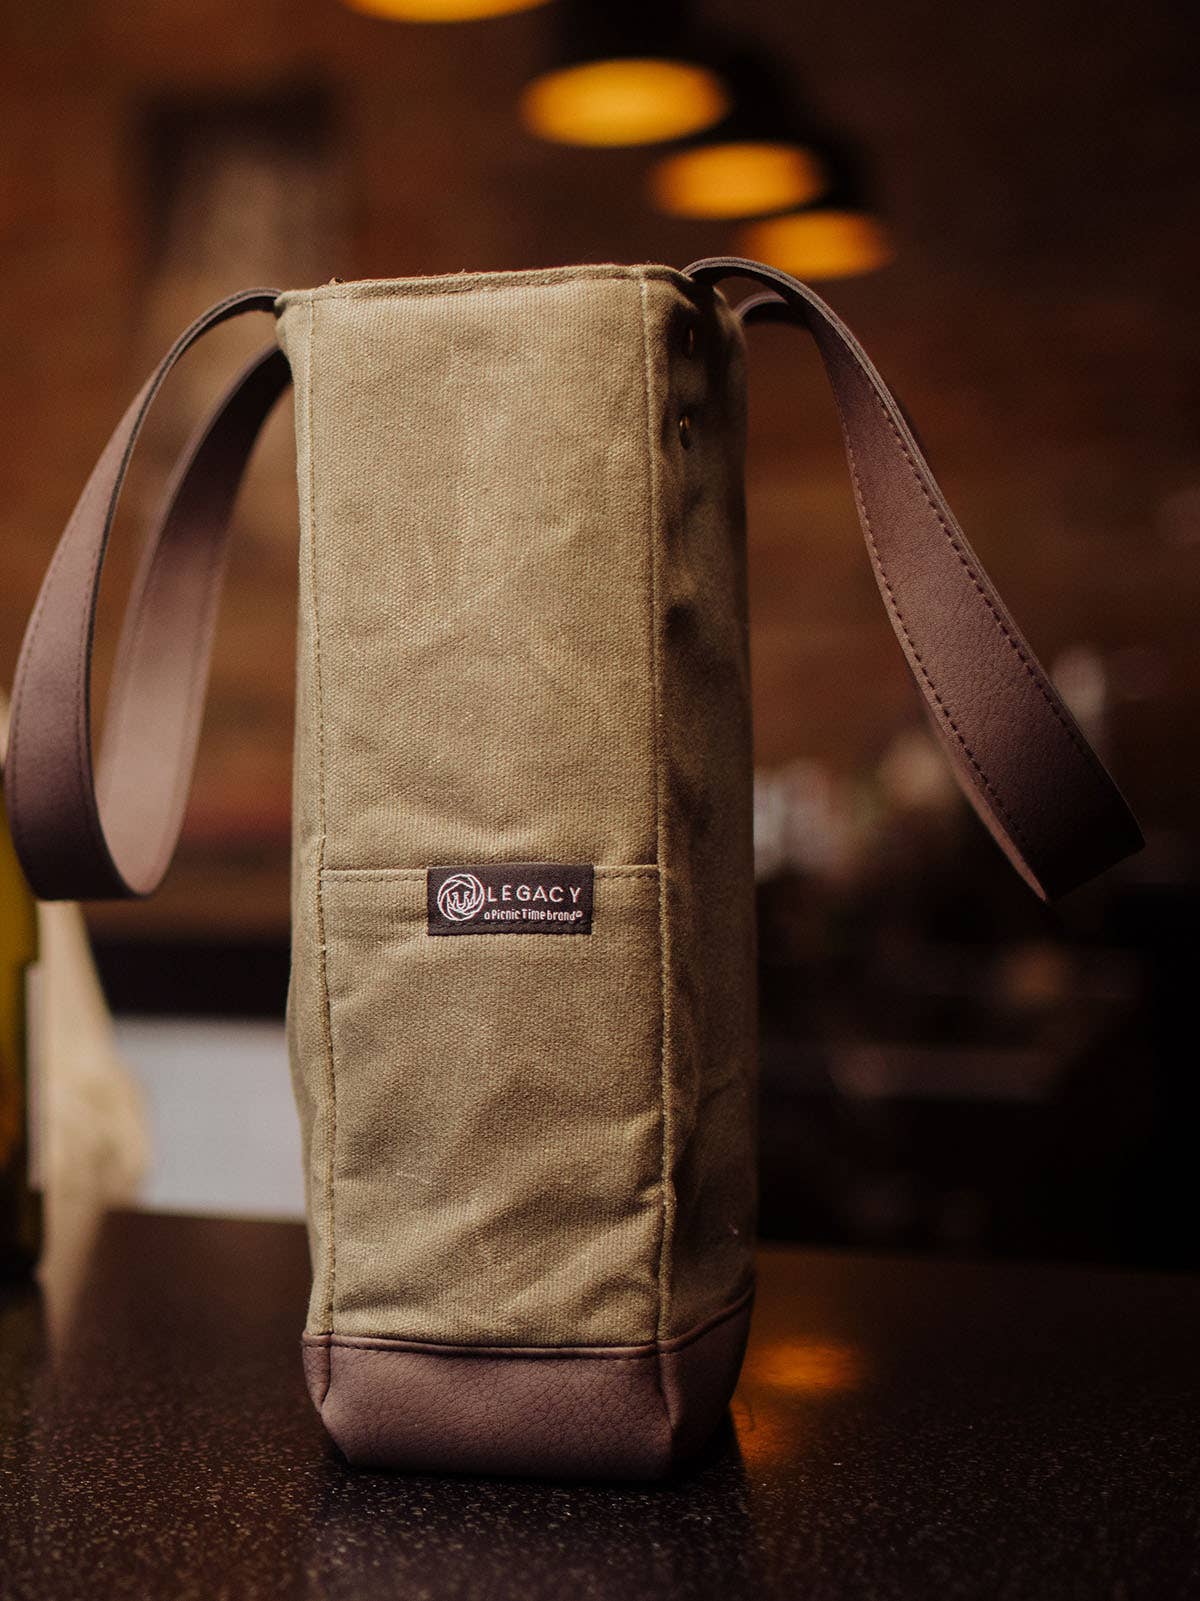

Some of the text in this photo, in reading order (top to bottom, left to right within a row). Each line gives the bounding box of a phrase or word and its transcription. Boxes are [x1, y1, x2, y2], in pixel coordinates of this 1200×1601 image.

[487, 884, 581, 903] LEGACY
[484, 911, 490, 920] a
[491, 909, 520, 921] Picnic
[521, 908, 547, 920] Time
